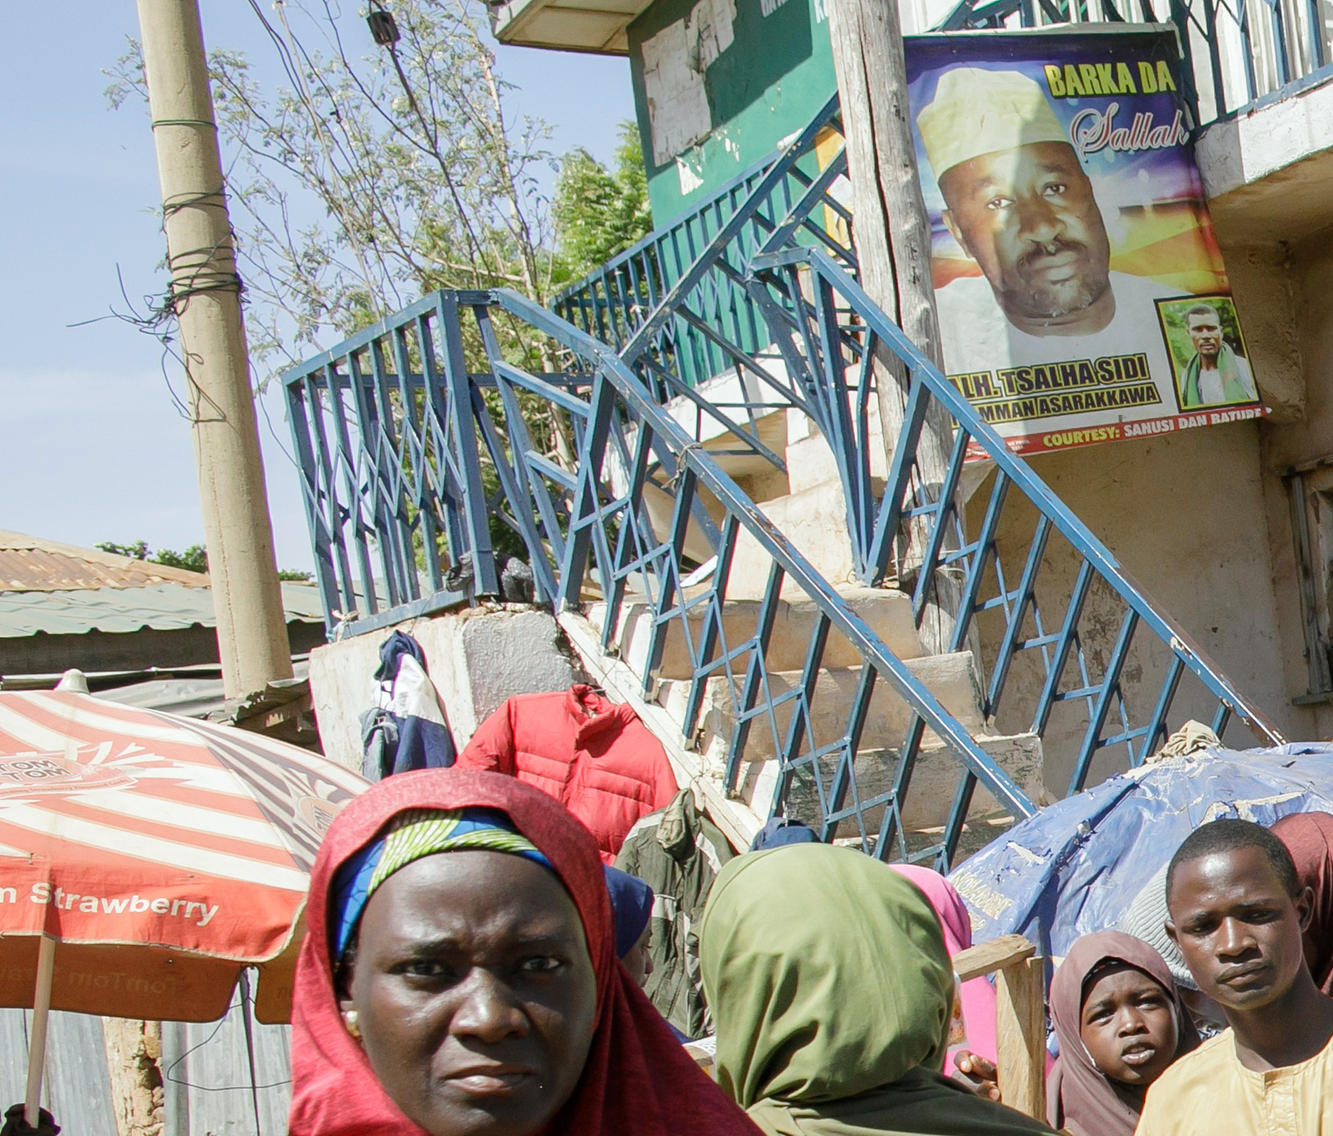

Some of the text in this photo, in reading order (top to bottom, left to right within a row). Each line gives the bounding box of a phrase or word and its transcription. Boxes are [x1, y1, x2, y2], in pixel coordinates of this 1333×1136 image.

[1044, 60, 1177, 97] BARKA DA
[1070, 102, 1190, 162] Sallah
[1000, 359, 1097, 394] TSALHA
[1097, 354, 1149, 384] SIDI
[1039, 384, 1161, 416] ASARAKKAWA
[1043, 427, 1120, 447] COURTESY:
[1124, 420, 1174, 437] SANUSI
[1179, 414, 1207, 429] DAN
[0, 759, 58, 772] TOM
[2, 768, 73, 782] TOM
[30, 882, 220, 926] Strawberry
